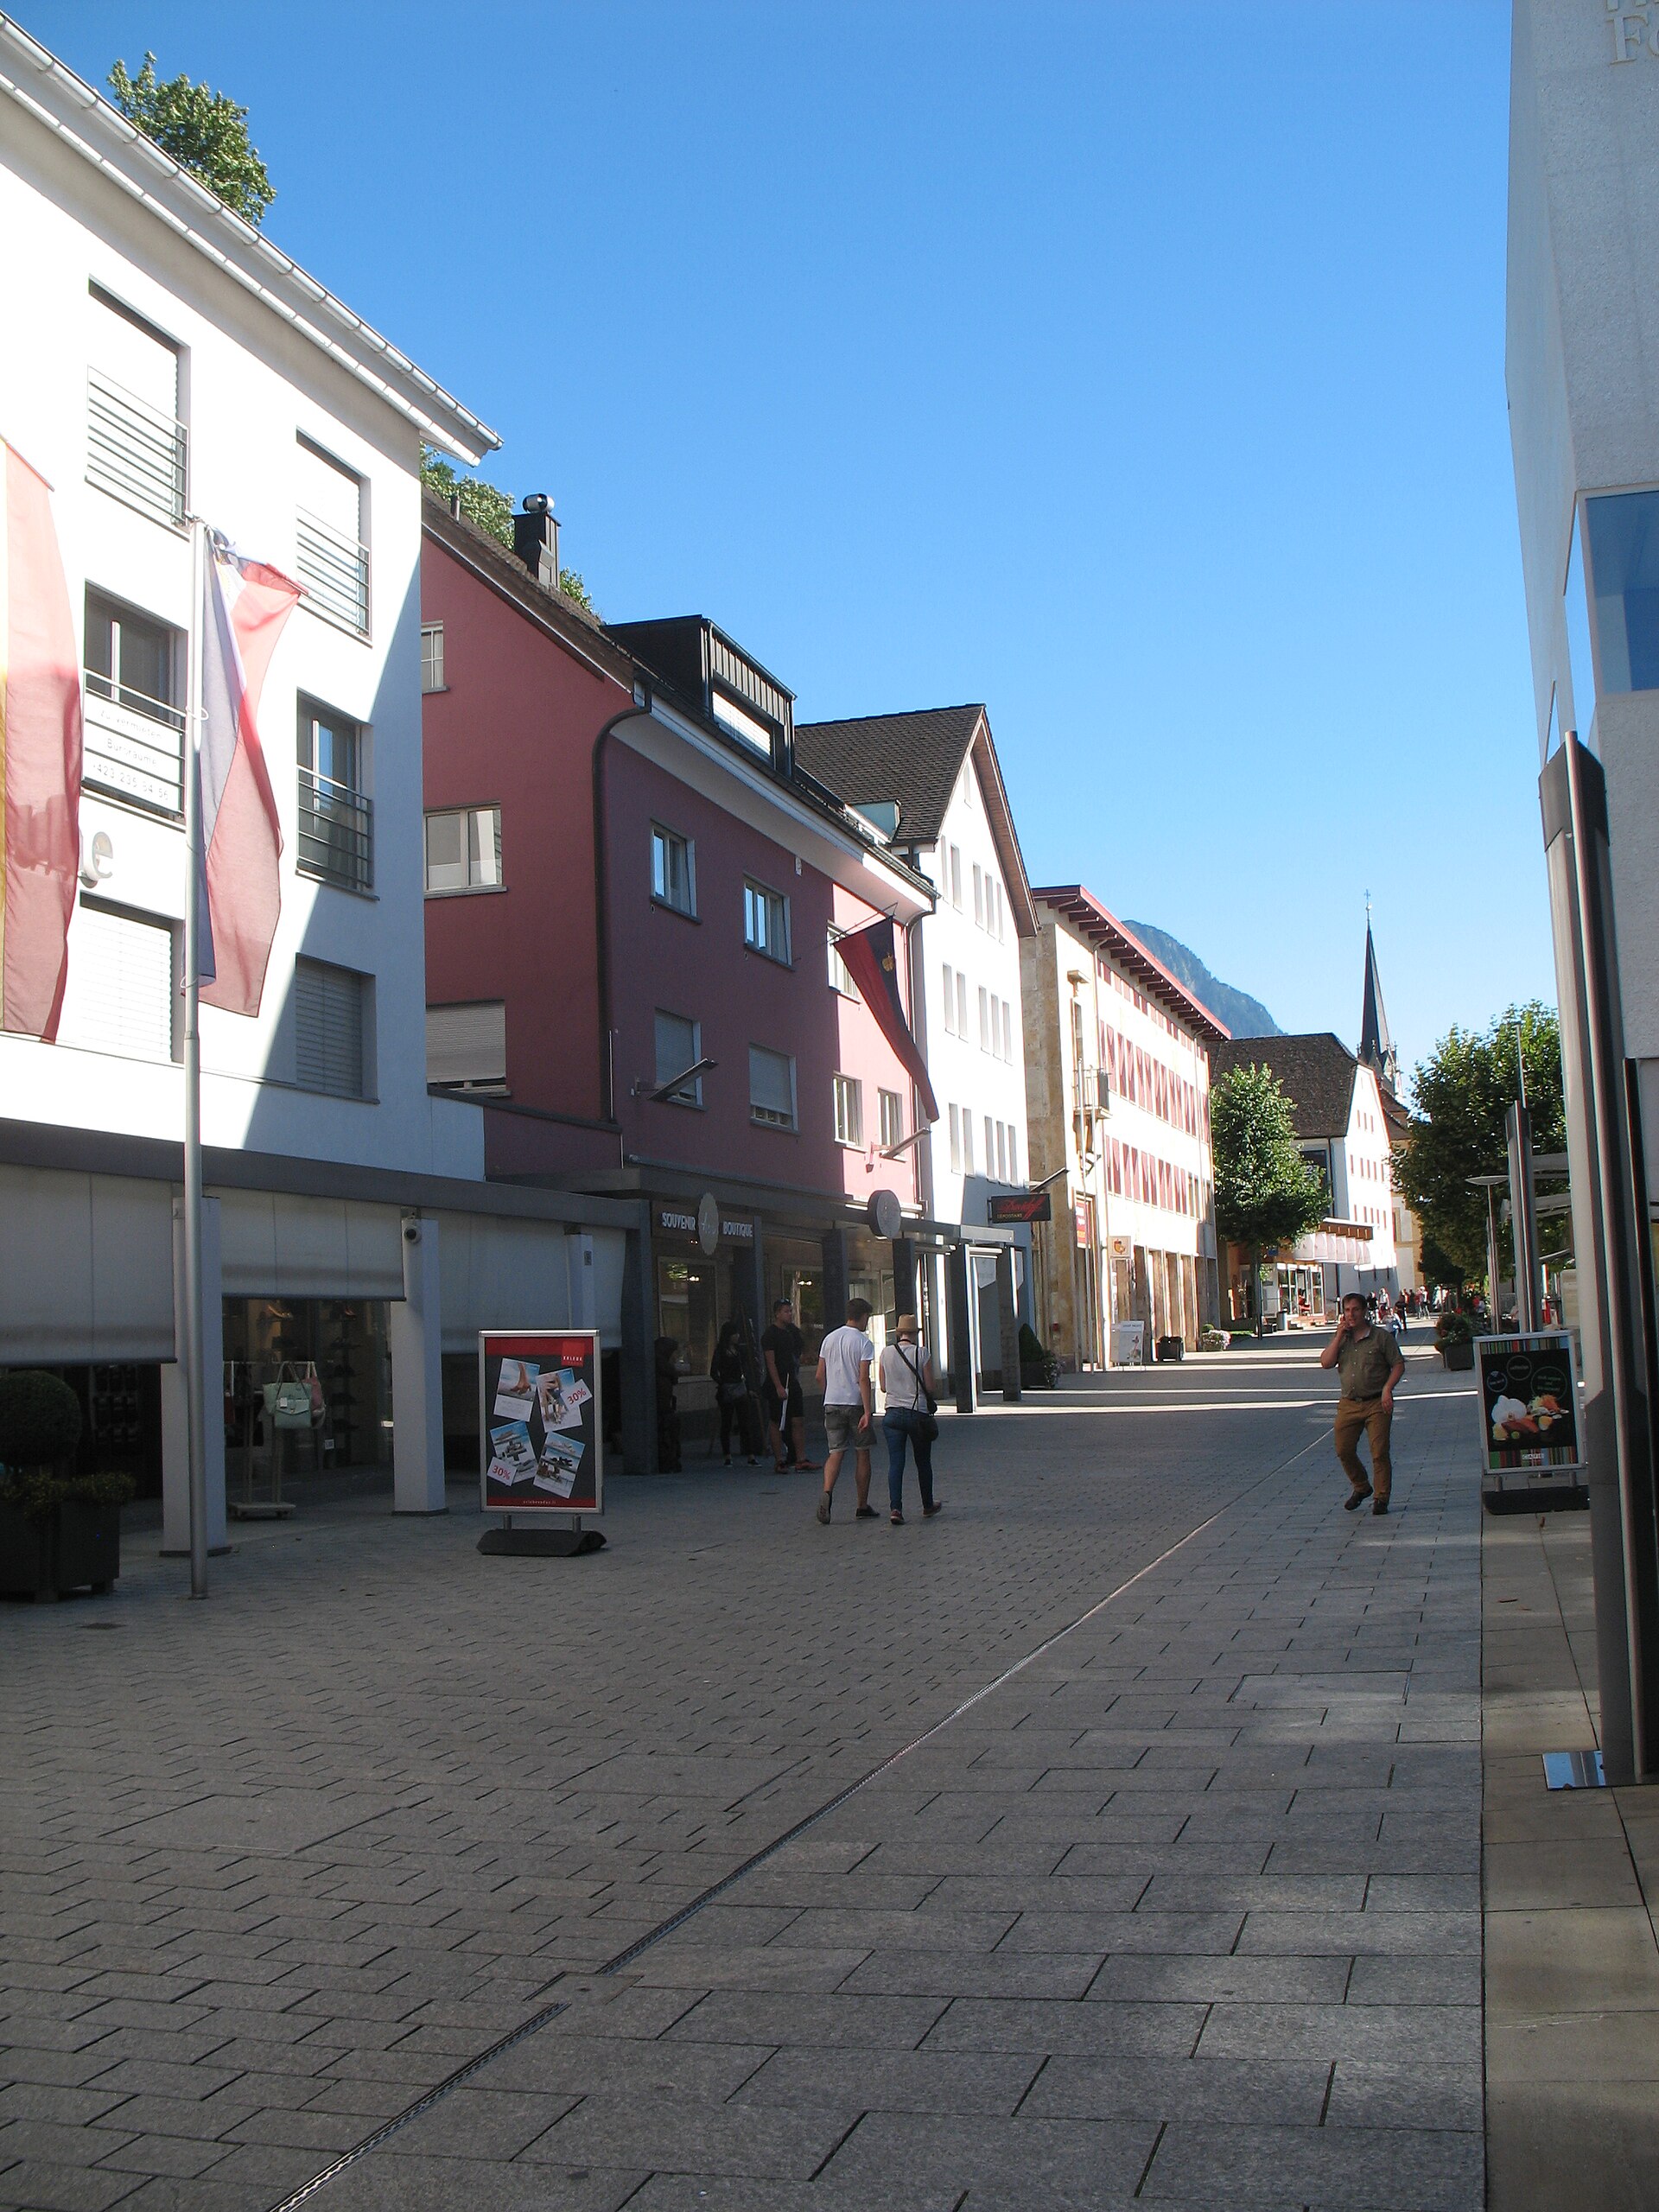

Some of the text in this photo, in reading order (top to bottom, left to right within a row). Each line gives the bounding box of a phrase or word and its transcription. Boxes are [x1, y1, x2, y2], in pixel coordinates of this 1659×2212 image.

[661, 1211, 696, 1231] SOUVENIR
[722, 1221, 753, 1238] BOUTIQUE
[567, 1388, 587, 1405] 30%
[492, 1465, 512, 1481] 30%
